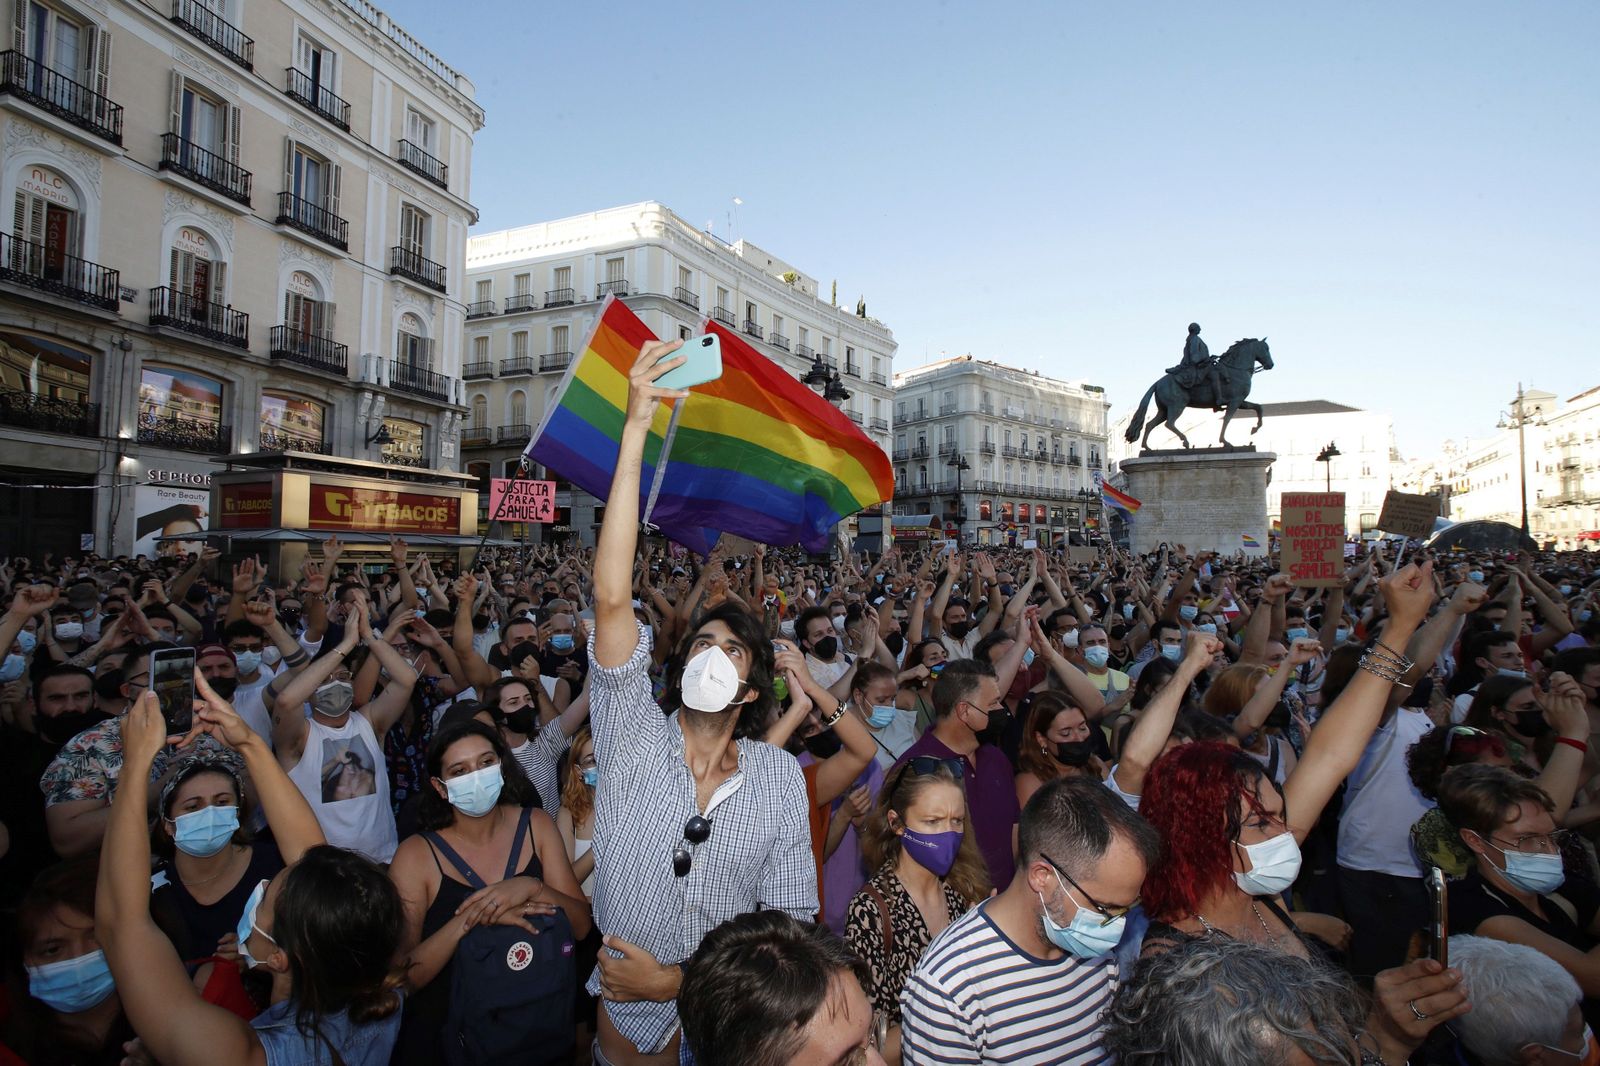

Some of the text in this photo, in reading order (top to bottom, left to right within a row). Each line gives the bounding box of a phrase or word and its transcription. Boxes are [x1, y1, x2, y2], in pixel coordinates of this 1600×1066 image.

[23, 180, 69, 203] MADRID
[48, 213, 61, 267] MADRID
[176, 240, 209, 258] MADRID
[147, 469, 212, 485] SEPHOR
[157, 489, 177, 498] Rare
[178, 491, 206, 501] Beauty
[497, 481, 549, 496] JUSTICIA
[238, 499, 273, 511] TABACOS
[508, 495, 536, 505] PARA
[364, 500, 448, 522] TABACOS
[497, 504, 543, 520] SAMUEL
[1305, 510, 1322, 523] DE
[1301, 551, 1325, 562] SER
[1289, 562, 1343, 580] SAMUEL
